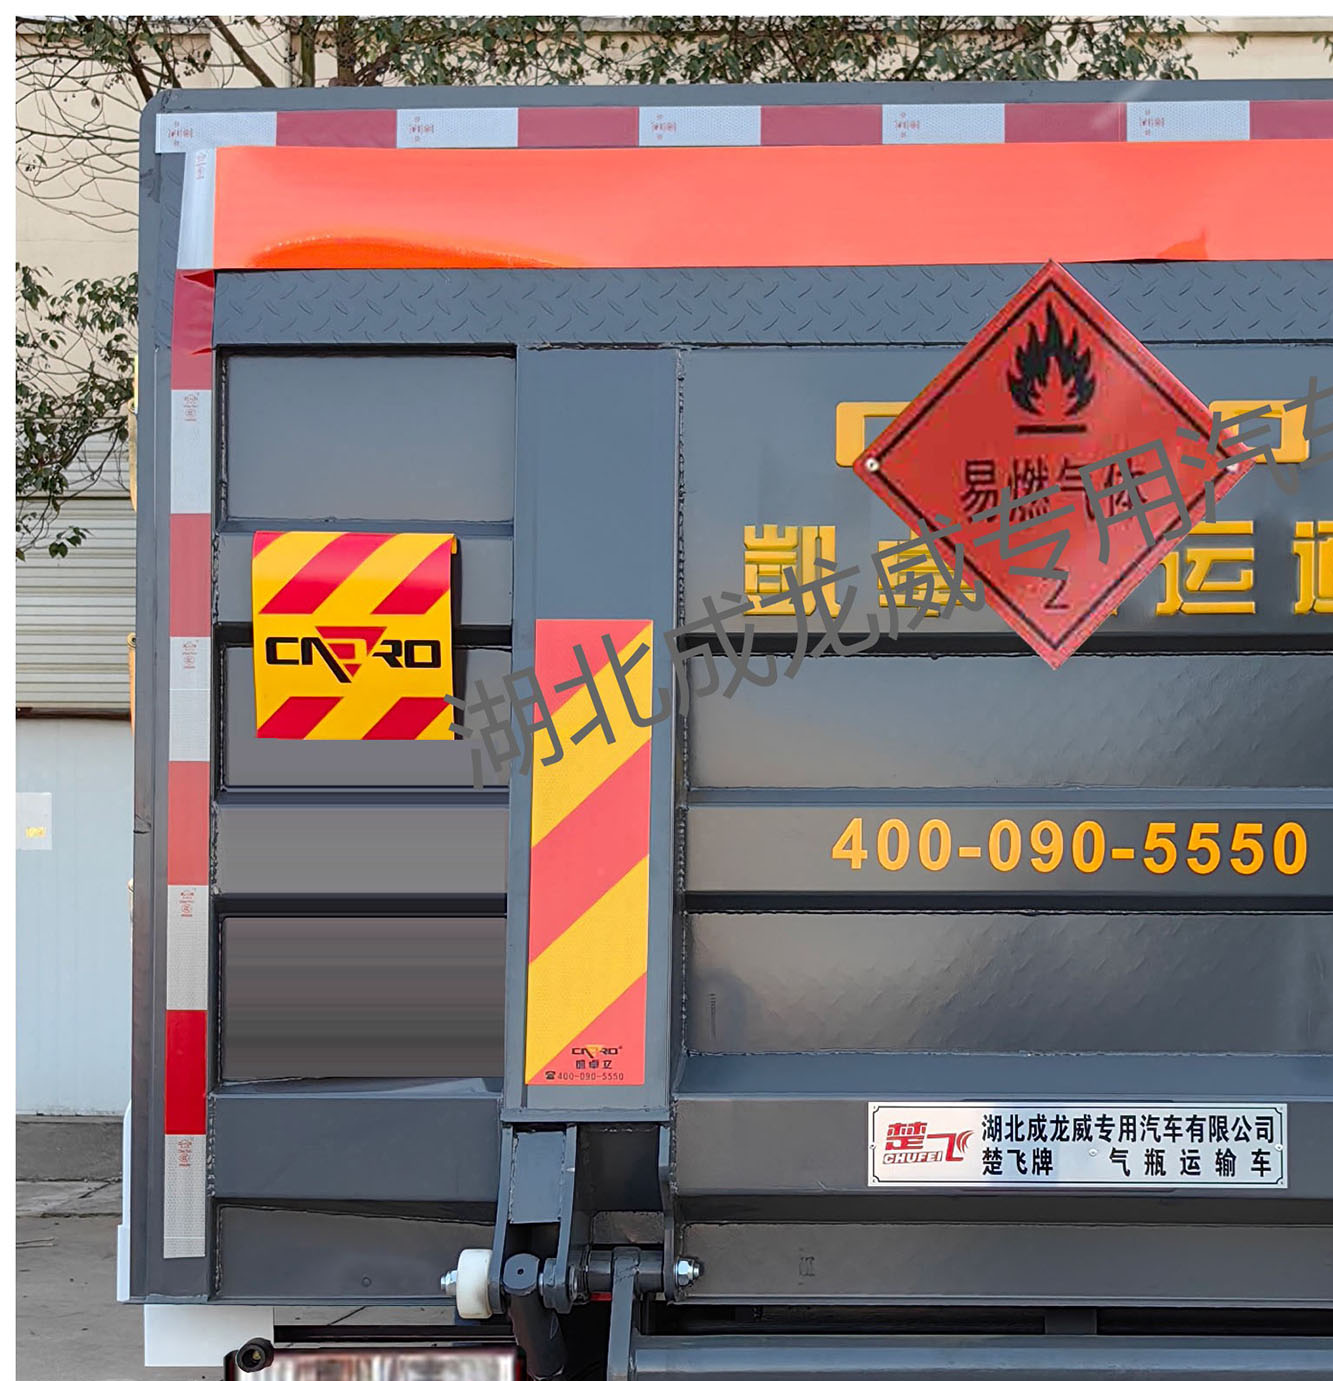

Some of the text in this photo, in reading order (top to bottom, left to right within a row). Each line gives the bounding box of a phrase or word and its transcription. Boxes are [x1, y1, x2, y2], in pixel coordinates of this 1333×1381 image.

[960, 456, 1148, 523] 易燃气体
[832, 818, 1309, 878] 400-090-5550
[981, 1113, 1276, 1144] 湖北成龙威专用汽车有限公司
[883, 1150, 943, 1165] CHUFEI
[981, 1147, 1273, 1177] 楚飞牌 气瓶运输车
